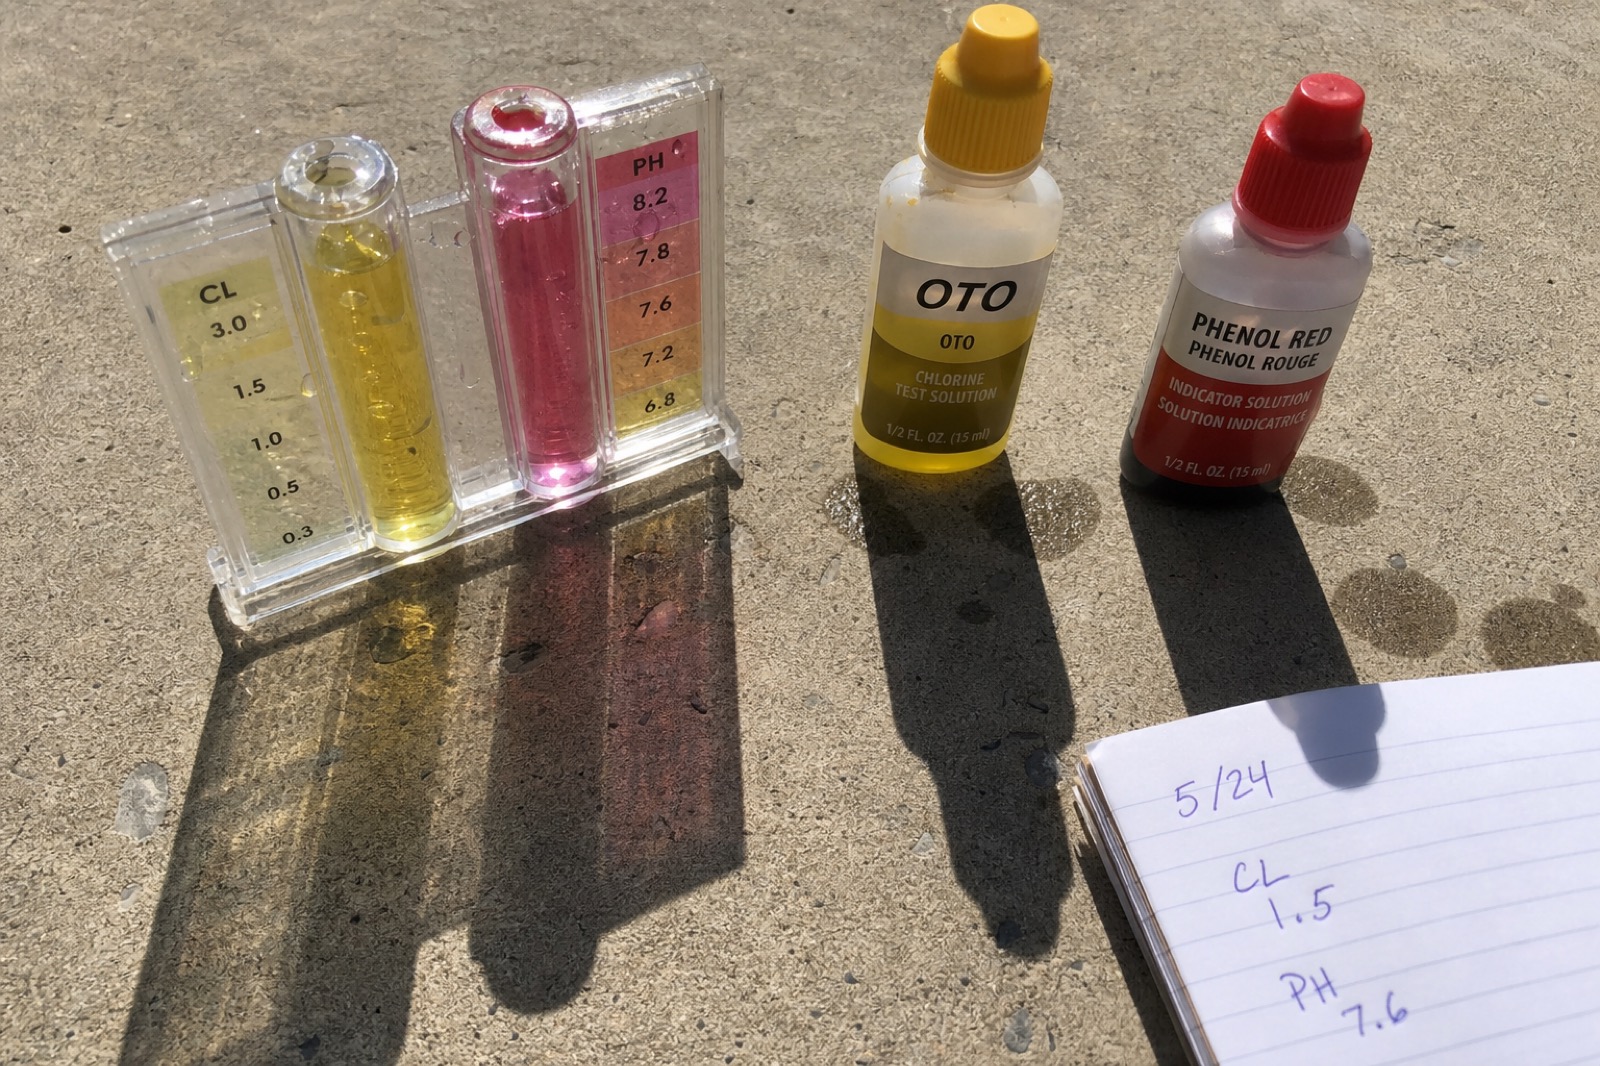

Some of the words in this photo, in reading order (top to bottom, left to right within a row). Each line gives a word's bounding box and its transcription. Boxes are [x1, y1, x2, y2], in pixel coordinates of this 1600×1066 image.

[633, 152, 664, 176] PH
[633, 187, 667, 211] 8.2
[636, 243, 669, 267] 7.8
[200, 281, 237, 304] CL
[917, 278, 1018, 312] OTO
[639, 296, 672, 318] 7.6
[210, 315, 247, 338] 3.0
[1191, 311, 1281, 349] PHENOL
[1288, 326, 1333, 349] RED
[940, 334, 975, 350] OTO
[642, 346, 674, 367] 7.2
[1188, 339, 1256, 370] PHENOL
[1261, 352, 1320, 371] ROUGE
[233, 378, 266, 399] 1.5
[915, 370, 985, 387] CHLORINE
[645, 392, 676, 413] 6.8
[895, 382, 928, 401] TEST
[928, 387, 998, 404] SOLUTION
[1168, 376, 1247, 408] INDICATOR
[1244, 389, 1313, 409] SOLUTION
[1157, 396, 1228, 429] SOLUTION
[1226, 409, 1308, 431] INDICATRICE
[251, 431, 283, 451] 1.0
[886, 423, 904, 438] 1/2
[906, 429, 924, 443] FL.
[927, 432, 947, 444] OZ.
[950, 431, 970, 445] (15
[971, 427, 991, 441] ml)
[1164, 455, 1183, 471] 1/2
[1185, 462, 1203, 475] FL.
[1206, 465, 1226, 478] OZ.
[1229, 465, 1250, 480] (15
[1250, 462, 1272, 476] ml)
[267, 479, 300, 500] 0.5
[282, 525, 314, 545] 0.3
[1174, 760, 1274, 818] 5/24
[1233, 859, 1290, 893] CL
[1268, 884, 1335, 930] 1.5
[1279, 967, 1338, 1011] PH
[1340, 990, 1408, 1037] 7.6
